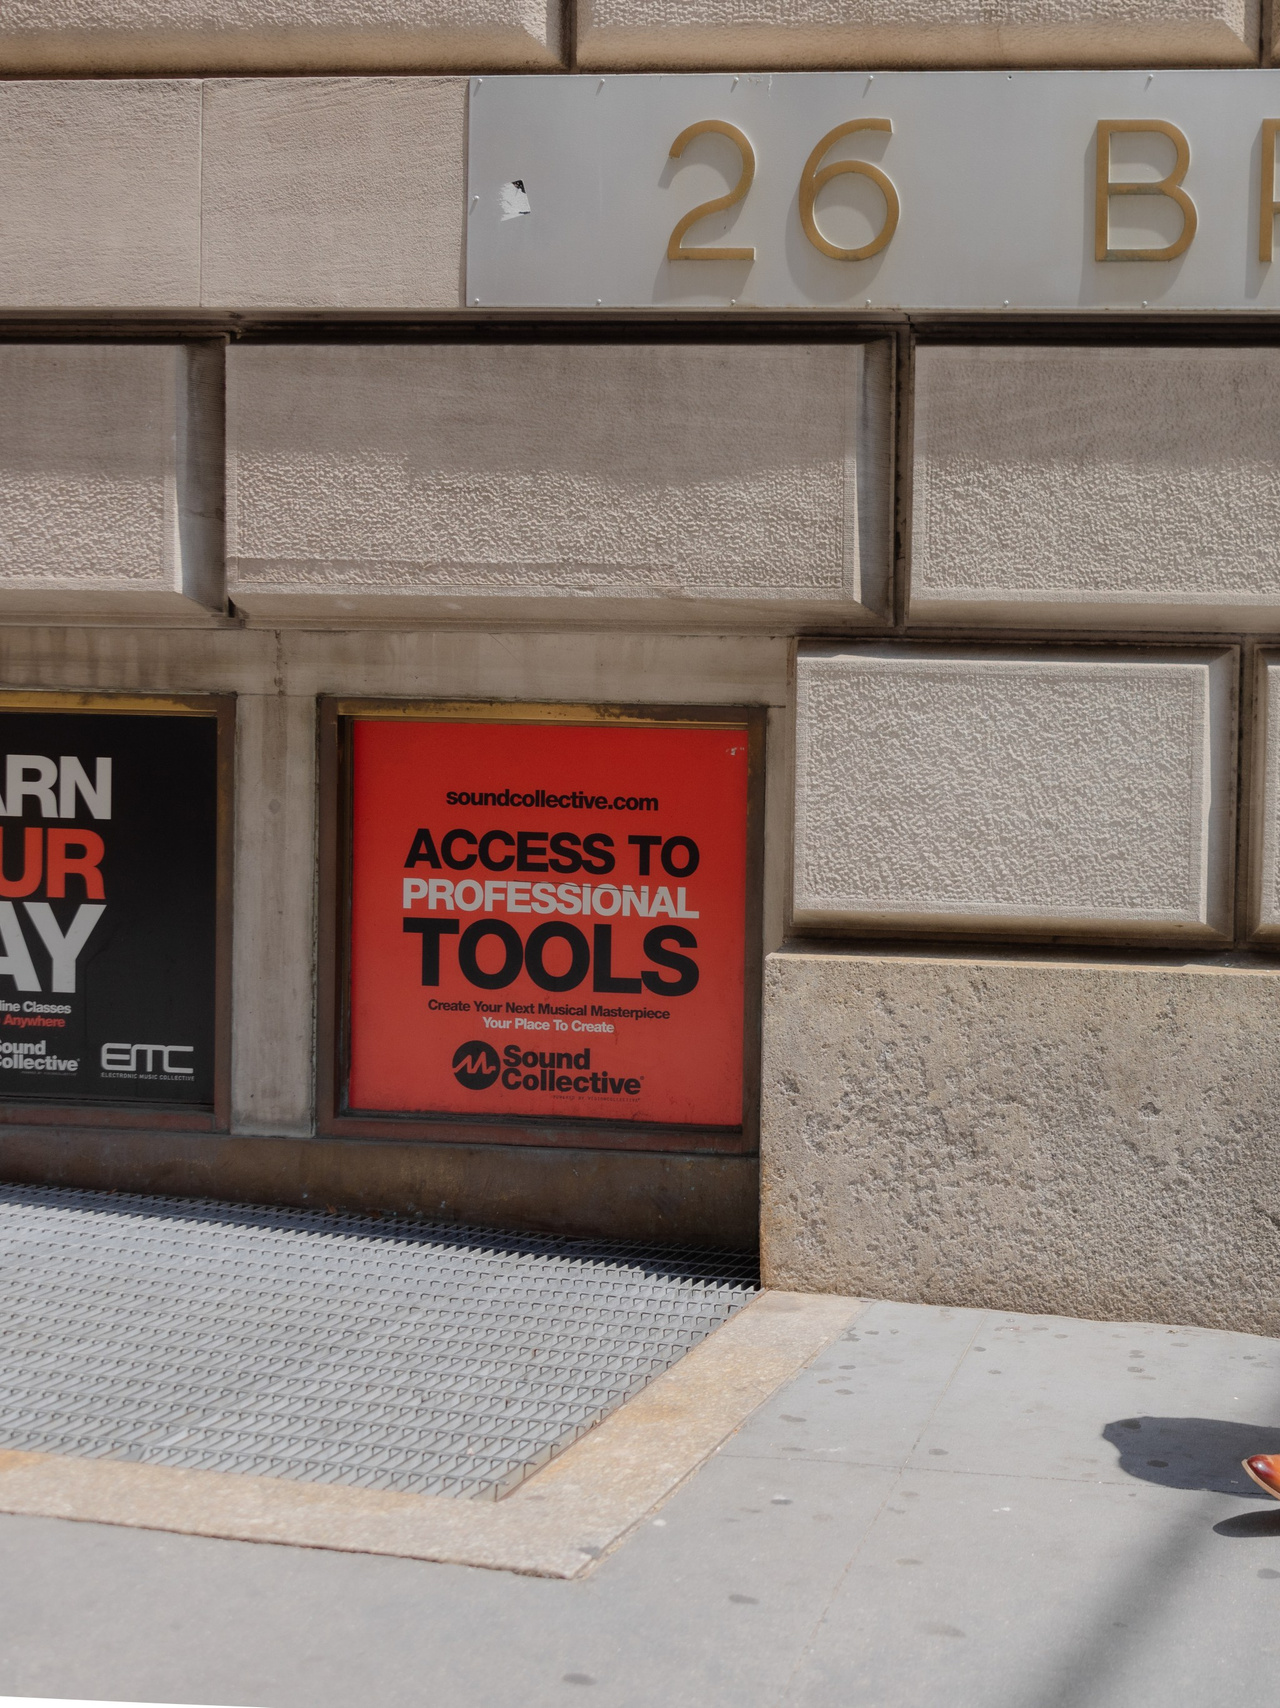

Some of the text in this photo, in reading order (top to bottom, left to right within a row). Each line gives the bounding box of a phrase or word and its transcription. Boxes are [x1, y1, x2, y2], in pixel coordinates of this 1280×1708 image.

[666, 117, 901, 262] 26
[0, 754, 112, 820] RN
[446, 788, 659, 811] soundcollective.com
[404, 828, 700, 878] ACCESS TO
[402, 877, 700, 919] PROFESSIONAL
[402, 917, 700, 997] TOOLS
[22, 1000, 72, 1014] Classes
[427, 999, 671, 1021] Create Your Next Musical Masterpiece
[3, 1013, 66, 1029] Anywhere
[482, 1016, 615, 1033] Your Place To Create
[0, 1039, 46, 1055] ound
[101, 1042, 194, 1074] EMC
[503, 1044, 591, 1070] Sound
[0, 1054, 80, 1072] ollective
[100, 1072, 138, 1080] ELECTRONIC
[159, 1074, 195, 1082] COLLECTIVE
